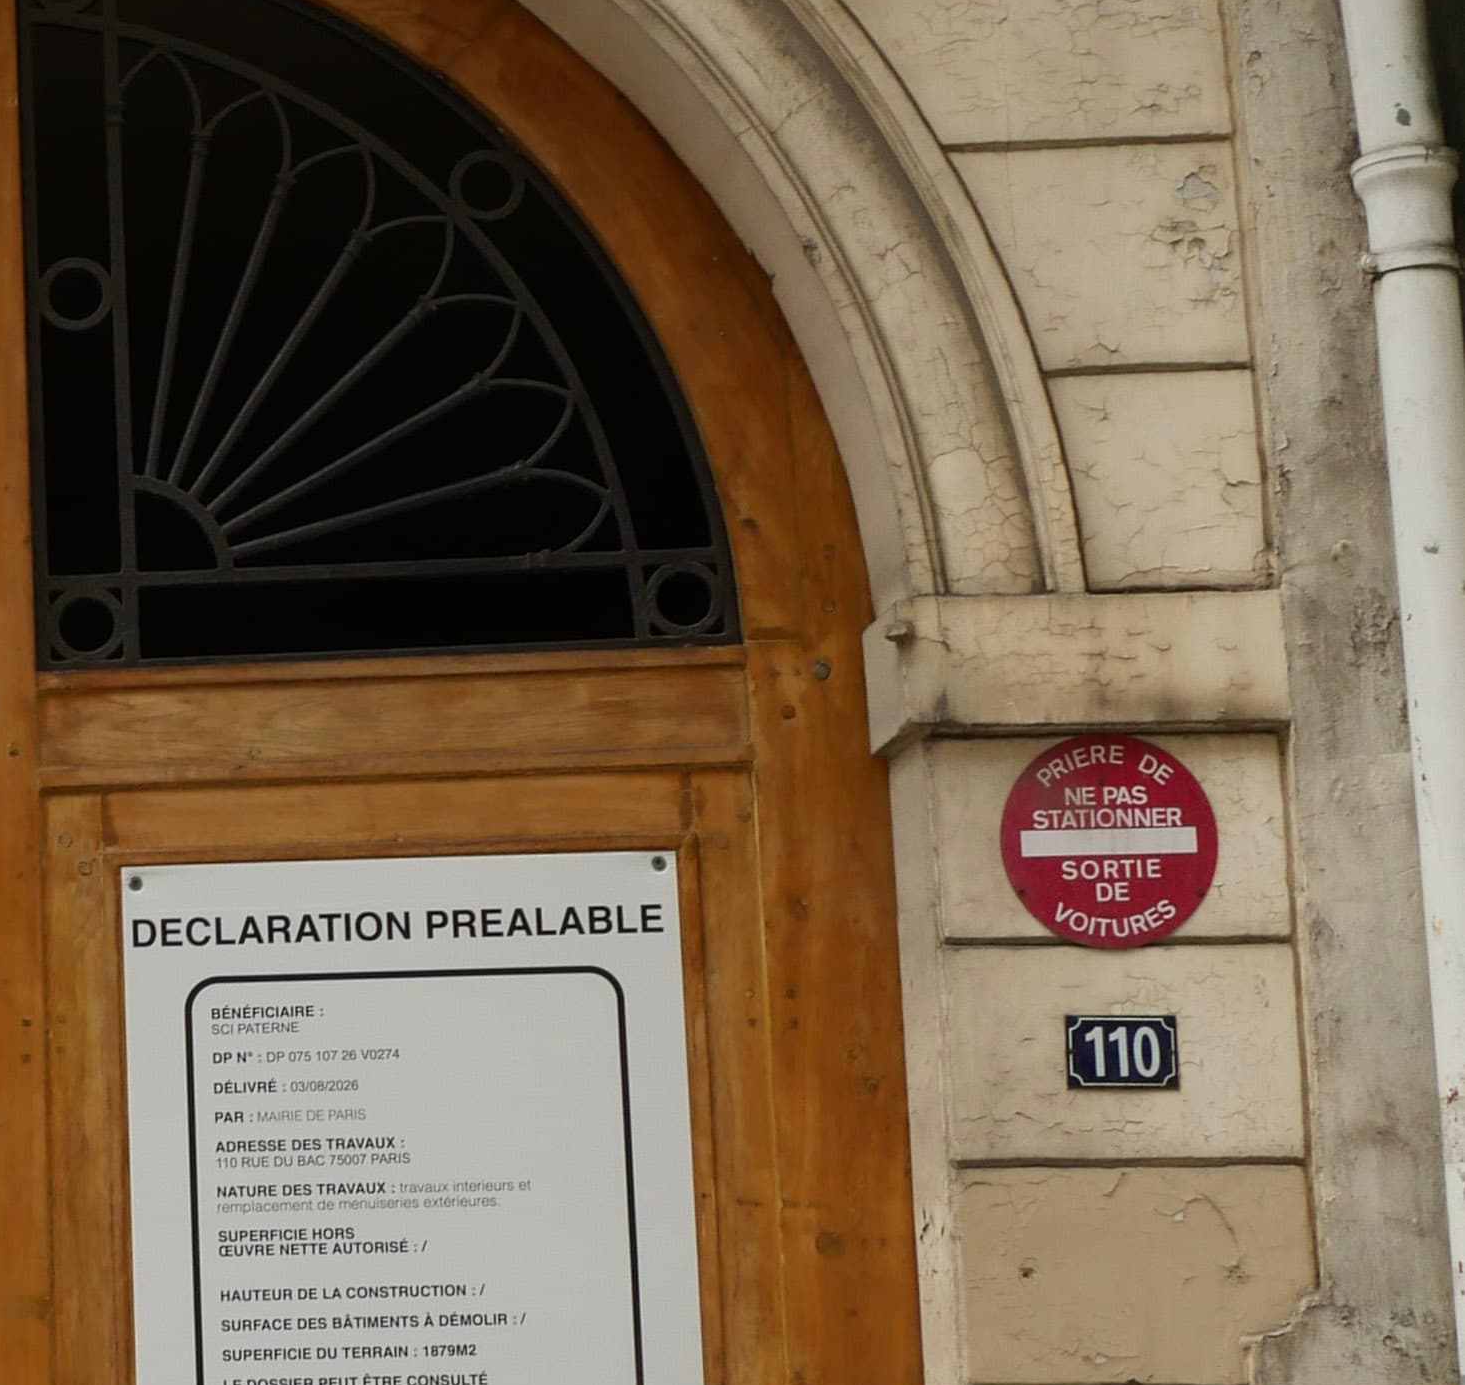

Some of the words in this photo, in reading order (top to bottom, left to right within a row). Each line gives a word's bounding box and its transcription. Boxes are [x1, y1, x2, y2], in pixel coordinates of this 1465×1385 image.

[1036, 745, 1124, 787] PRIERE
[1139, 753, 1174, 785] DE
[1064, 787, 1096, 806] NE
[1103, 786, 1148, 805] PAS
[1033, 807, 1182, 829] STATIONNER
[1062, 859, 1162, 880] SORTIE
[1096, 882, 1130, 902] DE
[132, 911, 410, 947] DECLARATION
[426, 904, 663, 938] PREALABLE
[1055, 899, 1176, 938] VOITURES
[210, 1003, 314, 1020] BÉNÉFICIAIRE
[210, 1022, 234, 1035] SCI
[237, 1020, 299, 1035] PATERNE
[211, 1051, 233, 1064] DP
[265, 1050, 285, 1063] DP
[287, 1050, 311, 1062] 075
[315, 1049, 338, 1061] 107
[1084, 1026, 1161, 1077] 110
[212, 1077, 277, 1094] DÉLIVRÉ
[213, 1110, 244, 1124] PAR
[256, 1109, 302, 1122] MAIRIE
[305, 1108, 323, 1121] DE
[327, 1108, 366, 1120] PARIS
[215, 1138, 286, 1153] ADRESSE
[291, 1138, 321, 1151] DES
[325, 1136, 395, 1150] TRAVAUX
[216, 1156, 238, 1168] 110
[240, 1155, 270, 1168] RUE
[273, 1155, 293, 1167] DU
[296, 1154, 325, 1167] BAC
[329, 1153, 366, 1166] 75007
[370, 1151, 411, 1164] PARIS
[216, 1184, 277, 1198] NATURE
[281, 1183, 312, 1196] DES
[315, 1181, 386, 1195] TRAVAUX
[399, 1181, 448, 1193] travaux
[518, 1180, 531, 1190] et
[216, 1199, 313, 1215] remplacement
[316, 1198, 335, 1211] de
[338, 1196, 419, 1210] menuiseries
[218, 1228, 308, 1243] SUPERFICIE
[312, 1227, 355, 1241] HORS
[279, 1242, 327, 1255] NETTE
[331, 1238, 409, 1254] AUTORISÉ
[219, 1287, 292, 1302] HAUTEUR
[297, 1287, 318, 1300] DE
[322, 1287, 342, 1300] LA
[345, 1283, 466, 1299] CONSTRUCTION
[220, 1317, 292, 1332] SURFACE
[296, 1316, 327, 1330] DES
[438, 1311, 507, 1326] DÉMOLIR
[221, 1347, 311, 1362] SUPERFICIE
[315, 1346, 337, 1359] DU
[341, 1345, 408, 1359] TERRAIN
[422, 1343, 476, 1357] 1879M2
